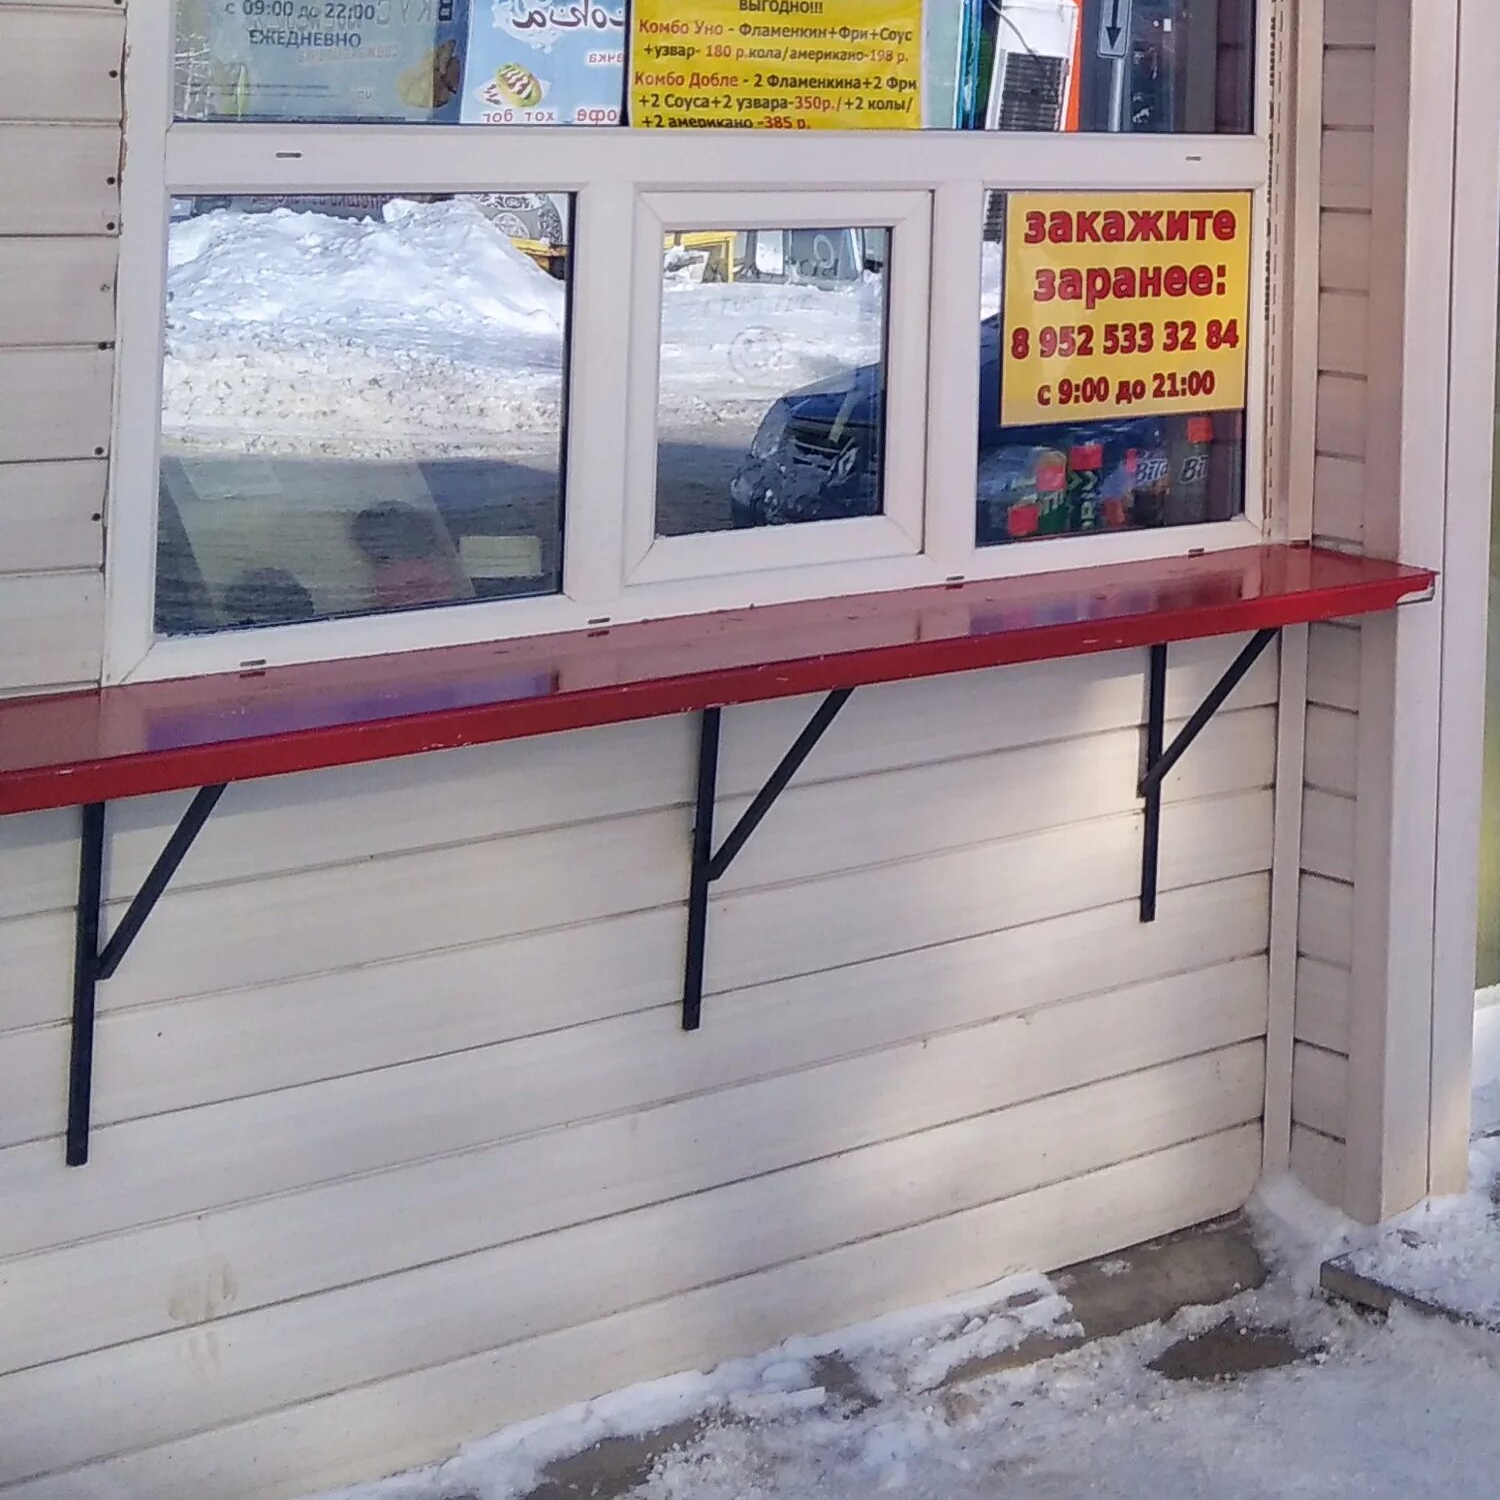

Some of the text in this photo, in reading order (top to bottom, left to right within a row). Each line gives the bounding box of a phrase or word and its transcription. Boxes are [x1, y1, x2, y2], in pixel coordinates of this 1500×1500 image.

[243, 0, 293, 17] 09:00
[300, 5, 319, 18] до
[325, 2, 375, 20] 22:00
[639, 19, 689, 34] Комбо
[694, 21, 723, 36] Уно
[249, 30, 362, 48] ЕЖЕДНЕВНО
[705, 45, 731, 58] 180
[635, 72, 685, 87] Комбо
[689, 72, 738, 88] Добле
[753, 74, 763, 87] 2
[886, 74, 917, 91] Фри
[1034, 265, 1226, 310] заранее:
[1011, 319, 1239, 359] 8 952 533 32 84
[1037, 370, 1215, 406] с 9:00 до 21:00
